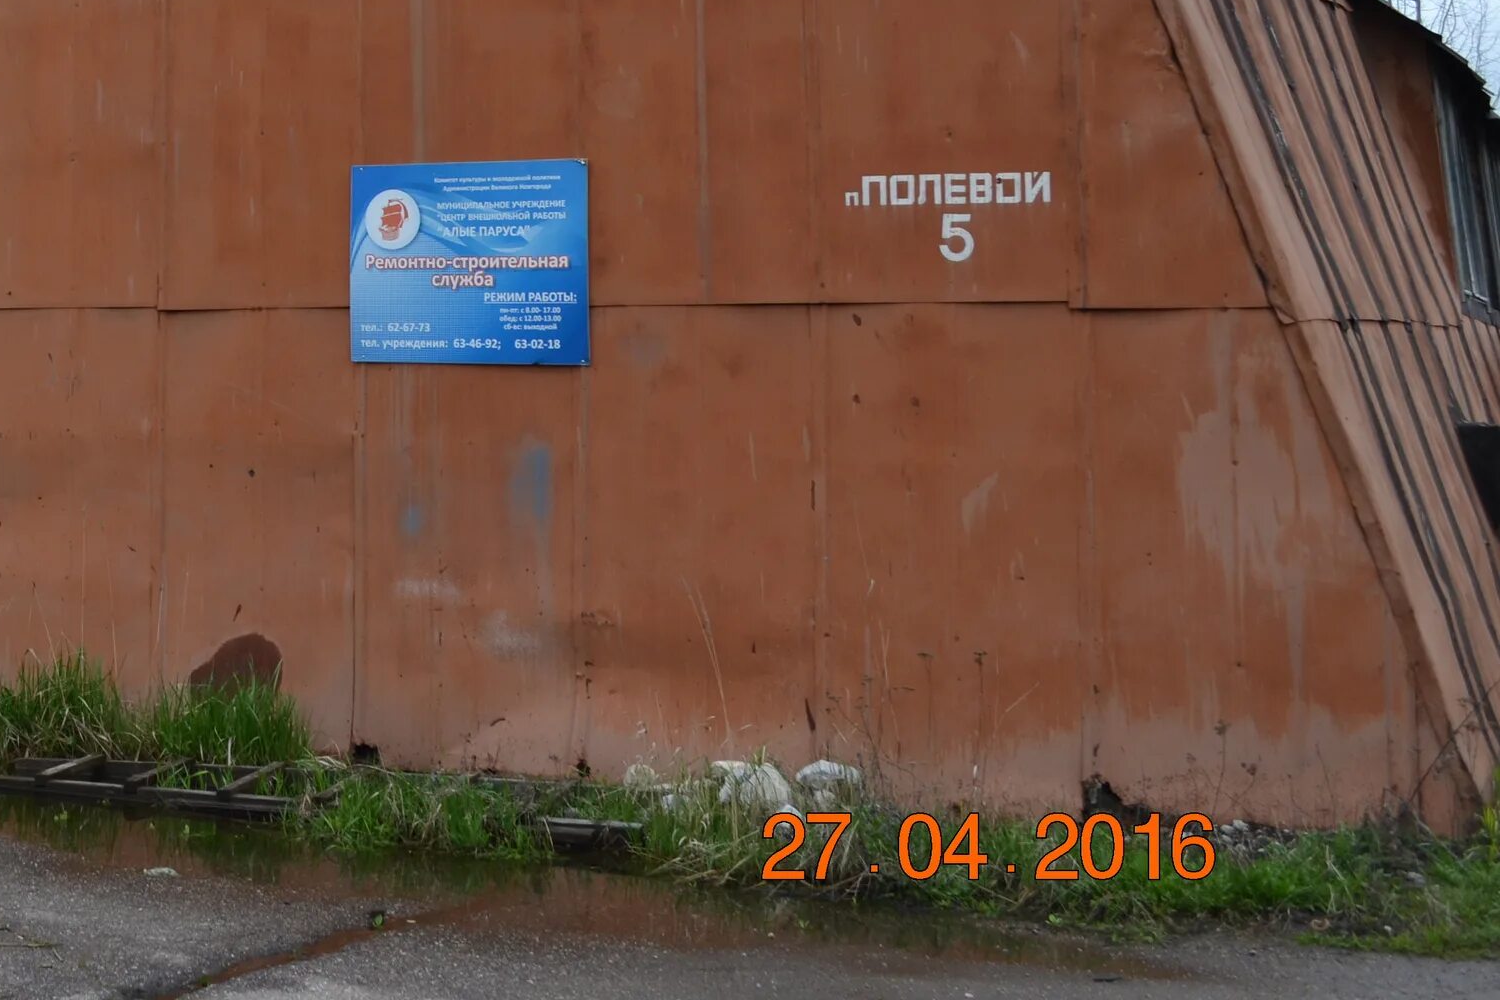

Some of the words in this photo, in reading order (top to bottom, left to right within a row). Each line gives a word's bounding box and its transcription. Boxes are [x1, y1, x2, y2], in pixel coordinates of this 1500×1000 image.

[436, 201, 510, 210] МУНИЦИПАЛЬНОЕ
[511, 200, 567, 209] УЧРЕЖДЕНИЕ
[468, 211, 531, 221] ВНЕШКОЛЬНОЙ
[532, 211, 567, 220] РАБОТЫ
[939, 213, 975, 262] 5
[364, 253, 570, 272] Ремонтно-строительная
[431, 270, 495, 290] служба
[483, 292, 526, 303] РЕЖИМ
[528, 291, 578, 303] РАБОТЫ:
[387, 322, 431, 332] 62-67-73
[361, 339, 380, 348] тел.
[382, 338, 449, 350] учреждения:
[453, 338, 501, 350] 63-46-92;
[514, 339, 561, 349] 63-02-18
